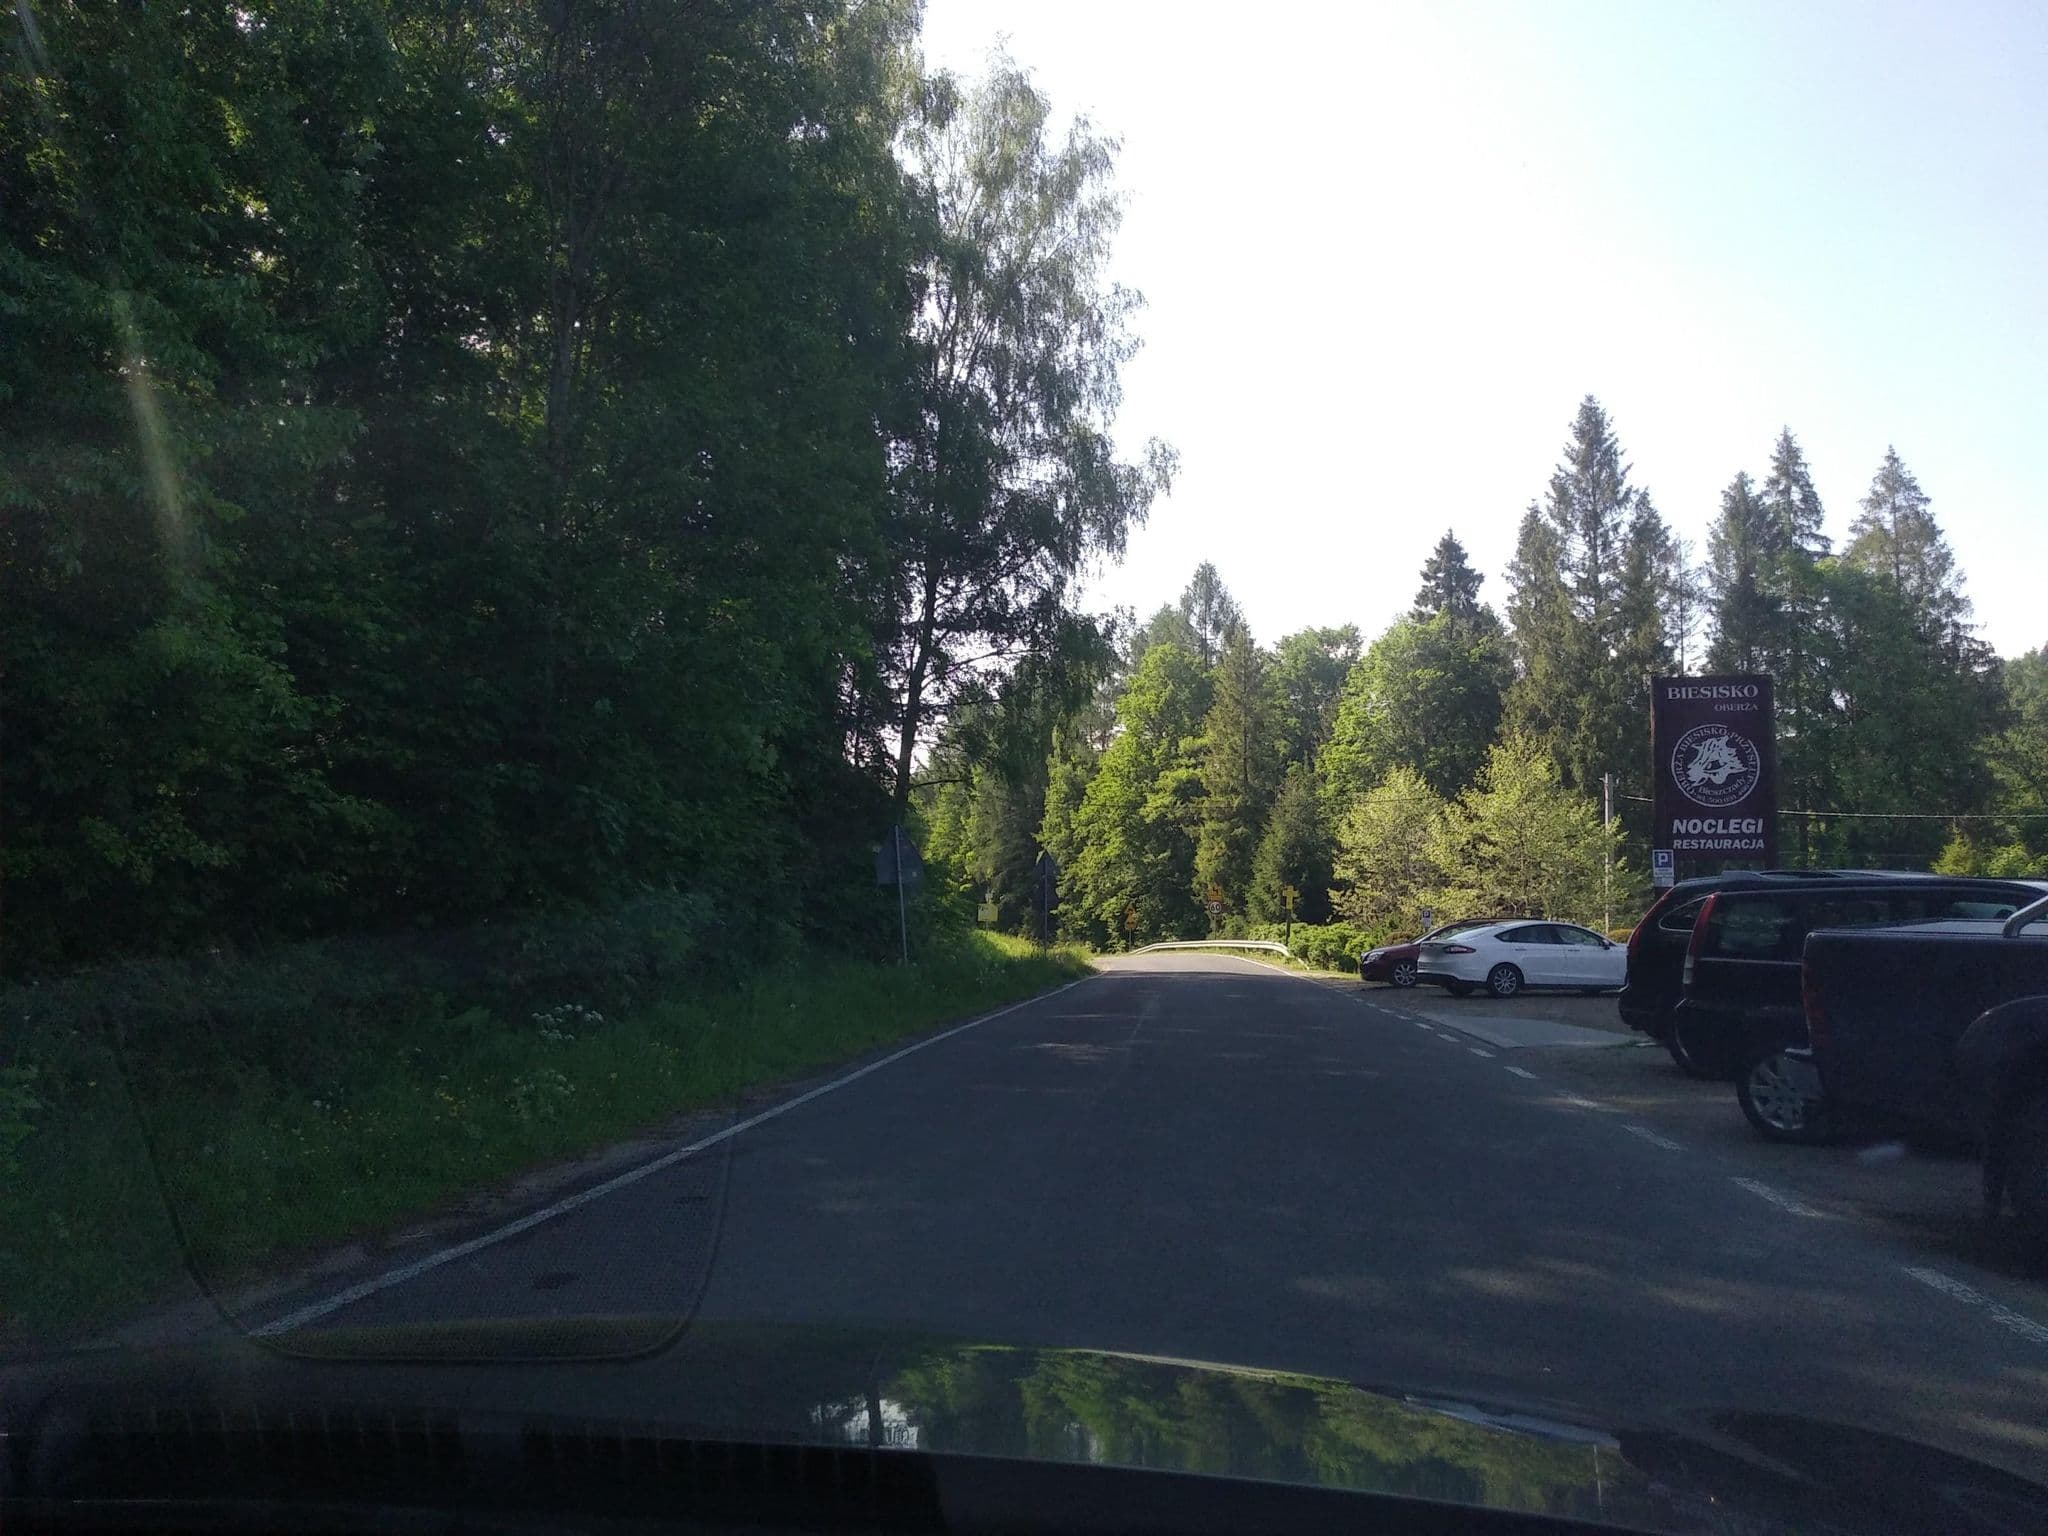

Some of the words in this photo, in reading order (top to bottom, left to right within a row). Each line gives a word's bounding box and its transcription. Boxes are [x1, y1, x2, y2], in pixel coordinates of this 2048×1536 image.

[1667, 685, 1759, 700] BIESISKO
[1680, 727, 1727, 751] BIESISKO
[1672, 818, 1764, 834] NOCLEGI
[1673, 839, 1765, 849] RESTAURACJA
[1658, 853, 1668, 866] P
